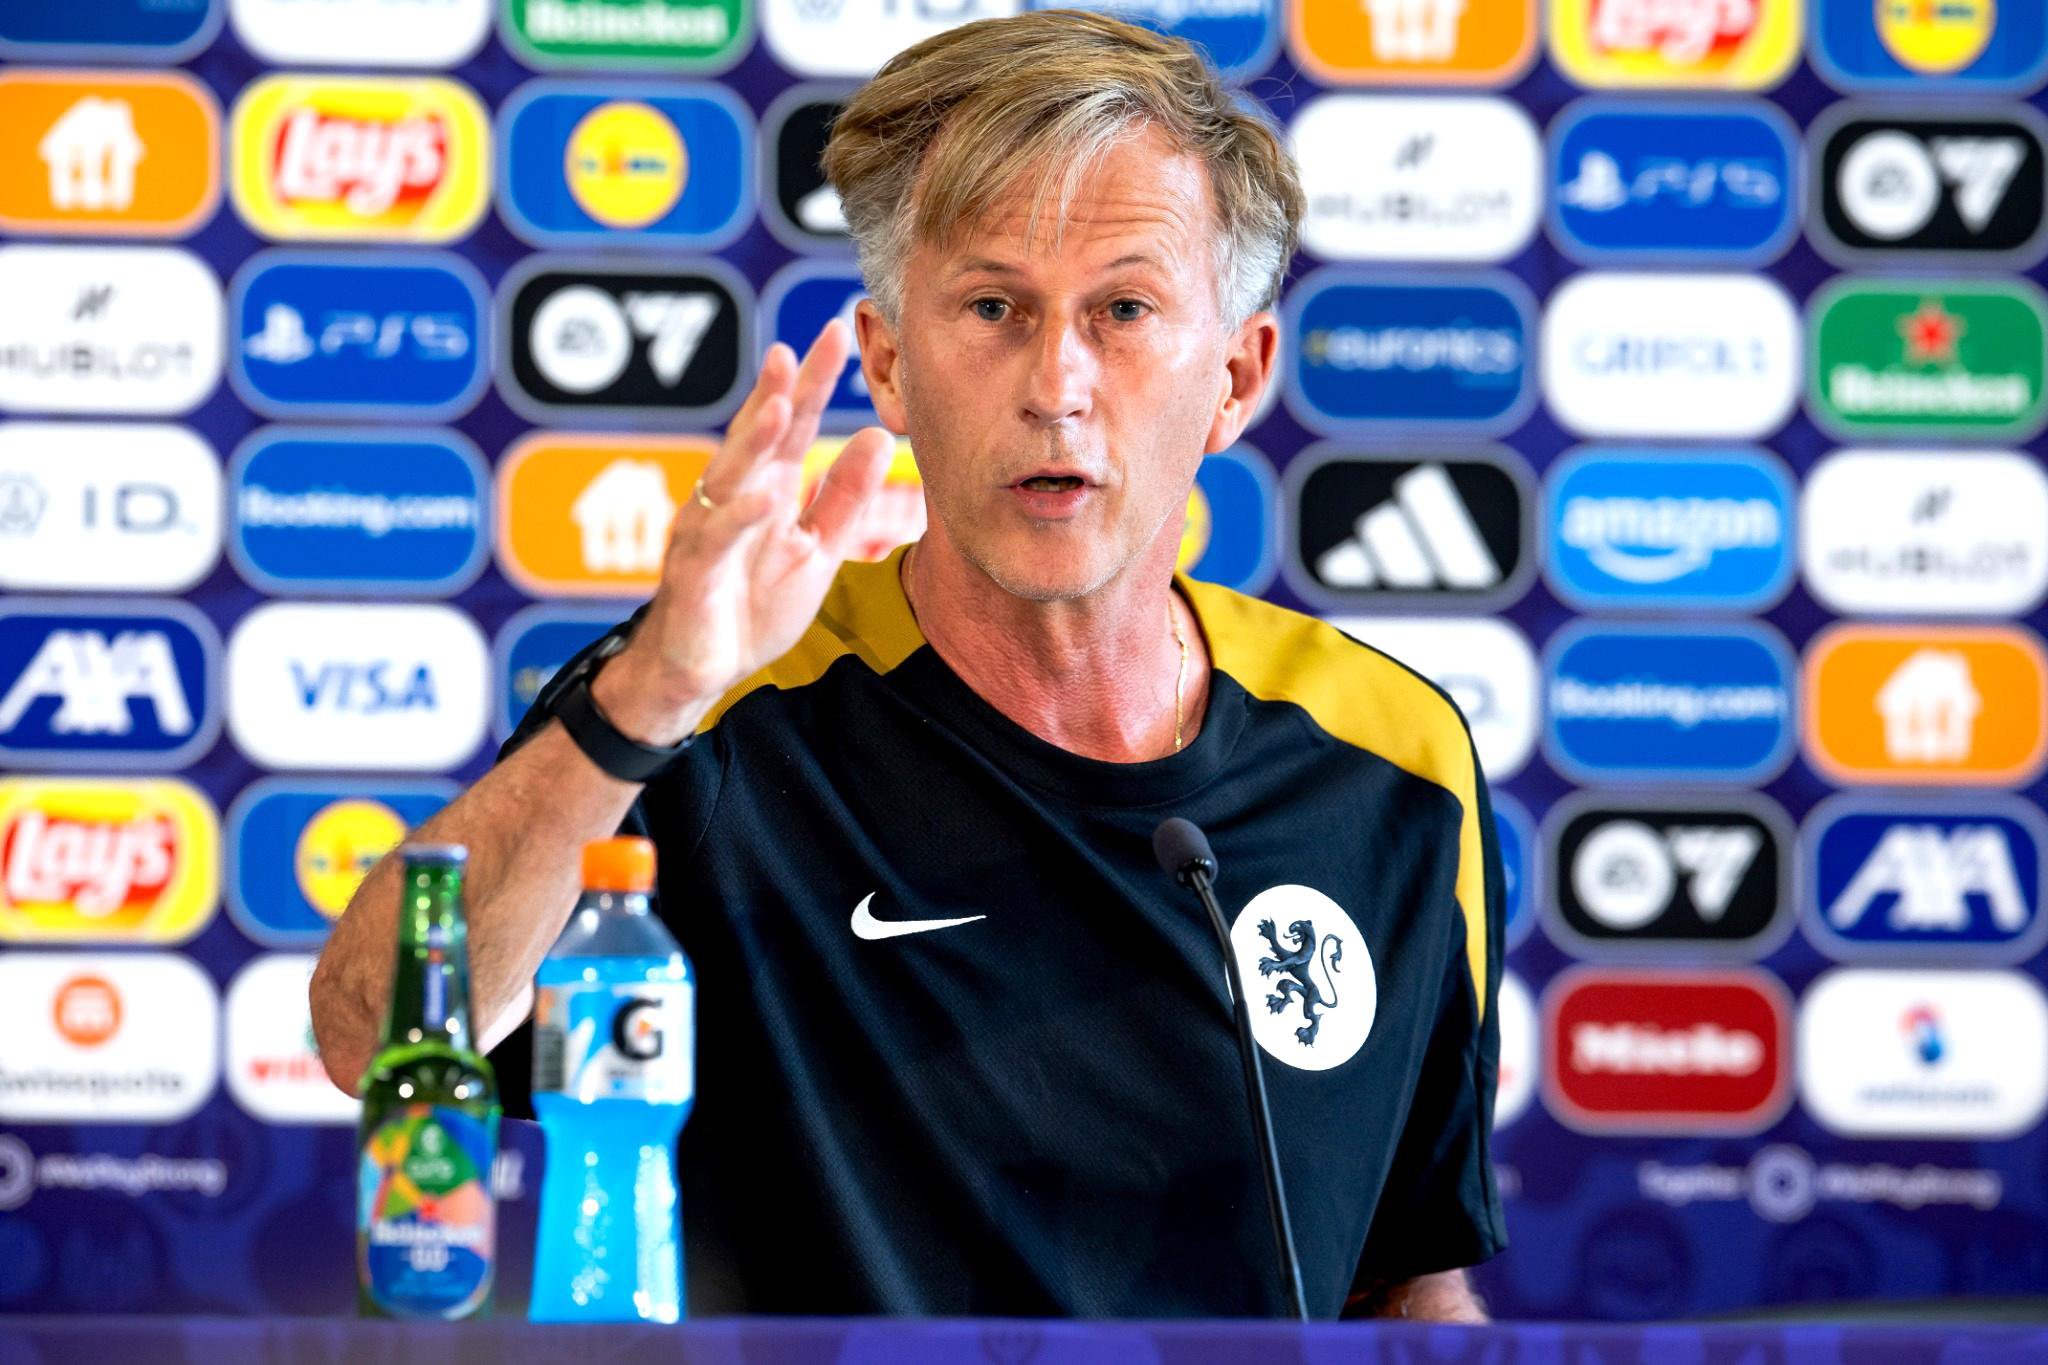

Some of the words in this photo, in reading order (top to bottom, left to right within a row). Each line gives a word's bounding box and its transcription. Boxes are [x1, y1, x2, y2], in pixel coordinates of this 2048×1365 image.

[318, 312, 471, 360] PS5
[1830, 364, 2033, 417] Heineken
[1562, 496, 1780, 562] amazon
[0, 630, 195, 736] AXA
[288, 660, 440, 713] VISA
[1828, 824, 2030, 932] AXA
[1570, 1021, 1765, 1077] Miele
